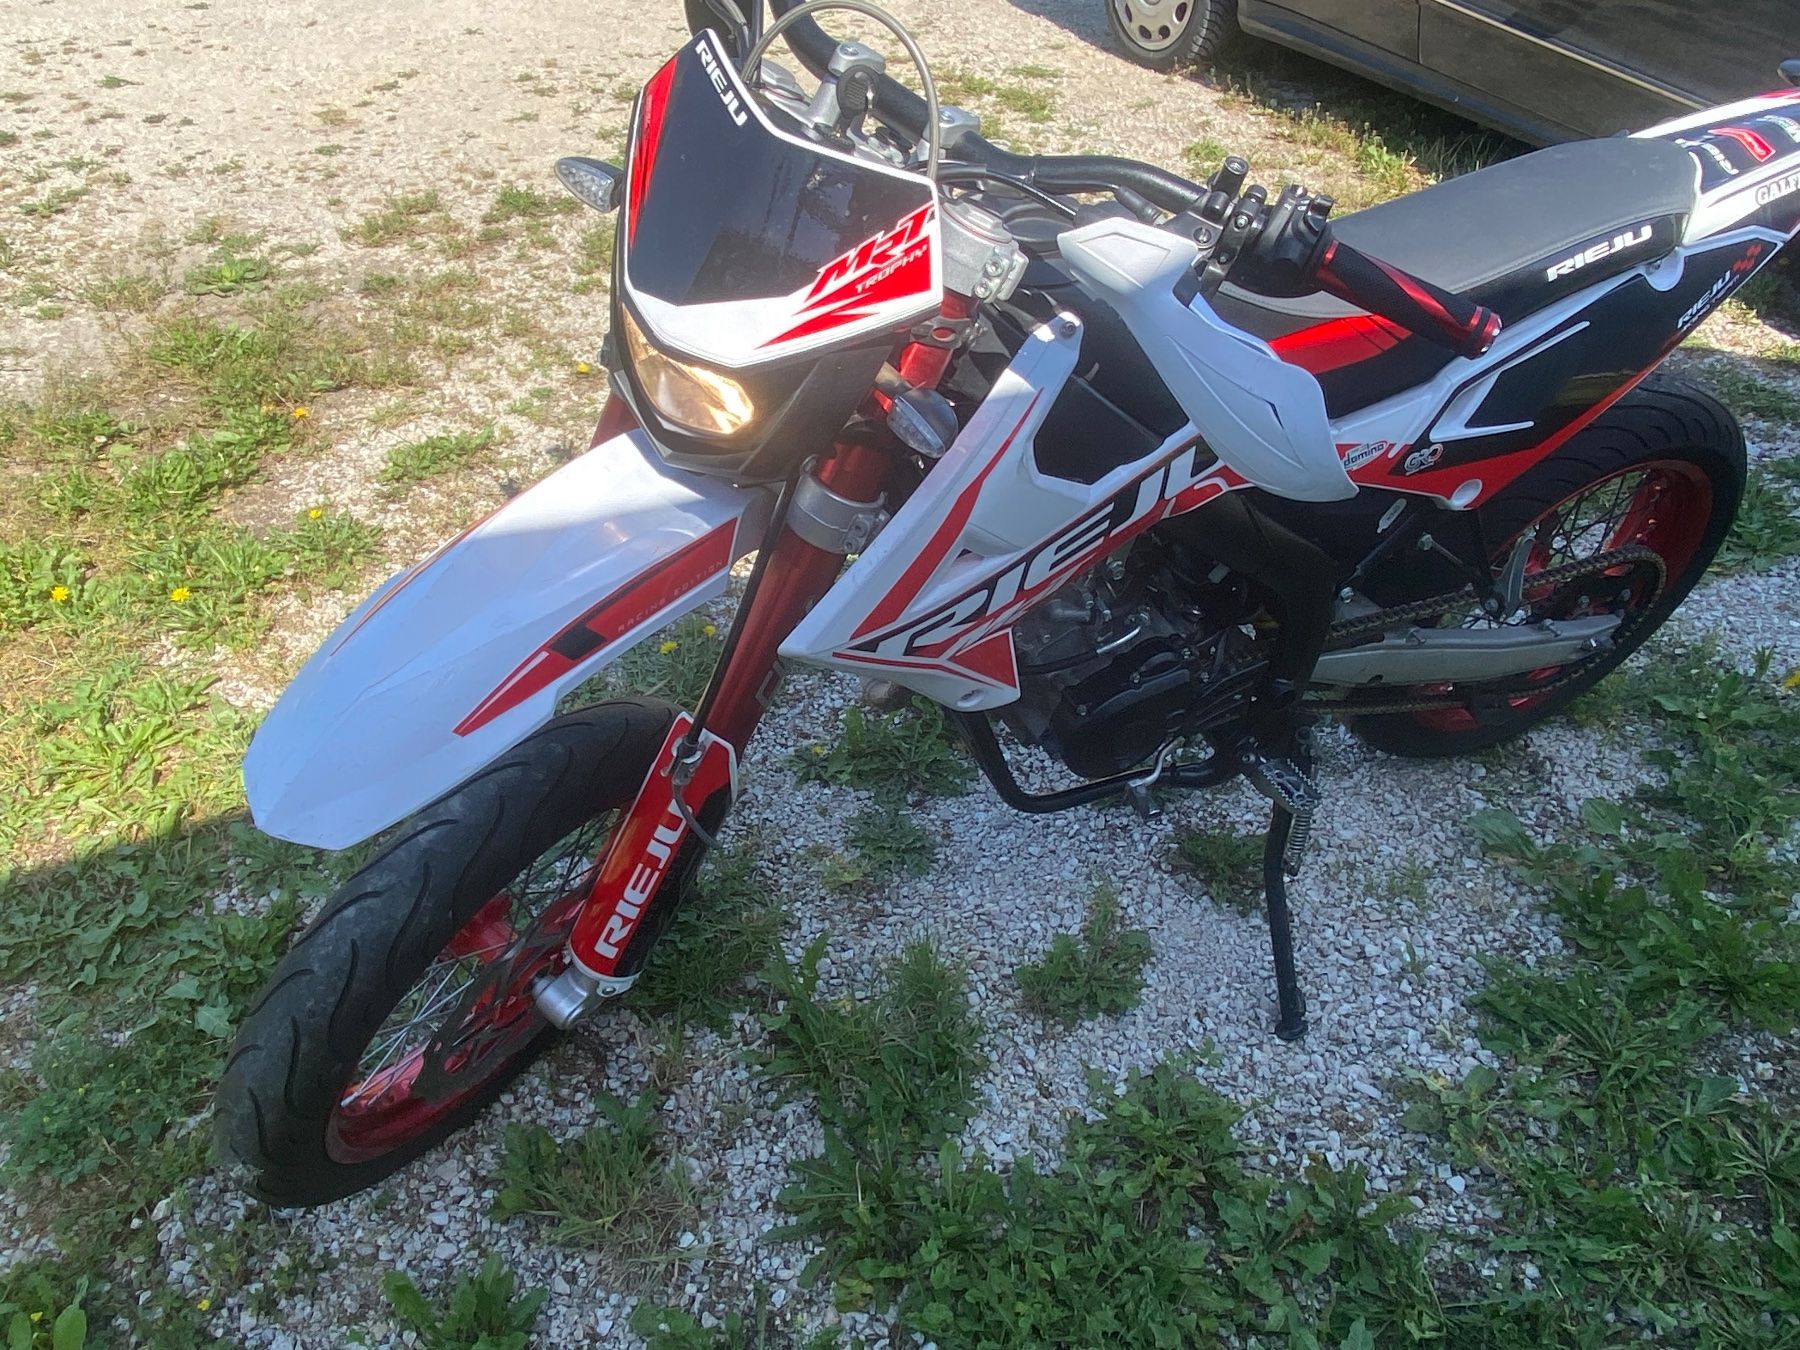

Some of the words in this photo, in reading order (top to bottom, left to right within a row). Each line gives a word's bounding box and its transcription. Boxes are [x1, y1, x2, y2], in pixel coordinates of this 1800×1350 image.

[695, 39, 748, 126] RIEJU
[1755, 171, 1800, 206] GALF
[803, 200, 936, 303] MRT
[855, 244, 928, 293] TROPHY
[1546, 225, 1652, 282] RIEJU
[1678, 270, 1730, 329] RIEJU
[1343, 443, 1385, 468] domino
[617, 598, 666, 633] RACING
[673, 562, 722, 596] EDITION
[594, 799, 693, 959] RIEJU
